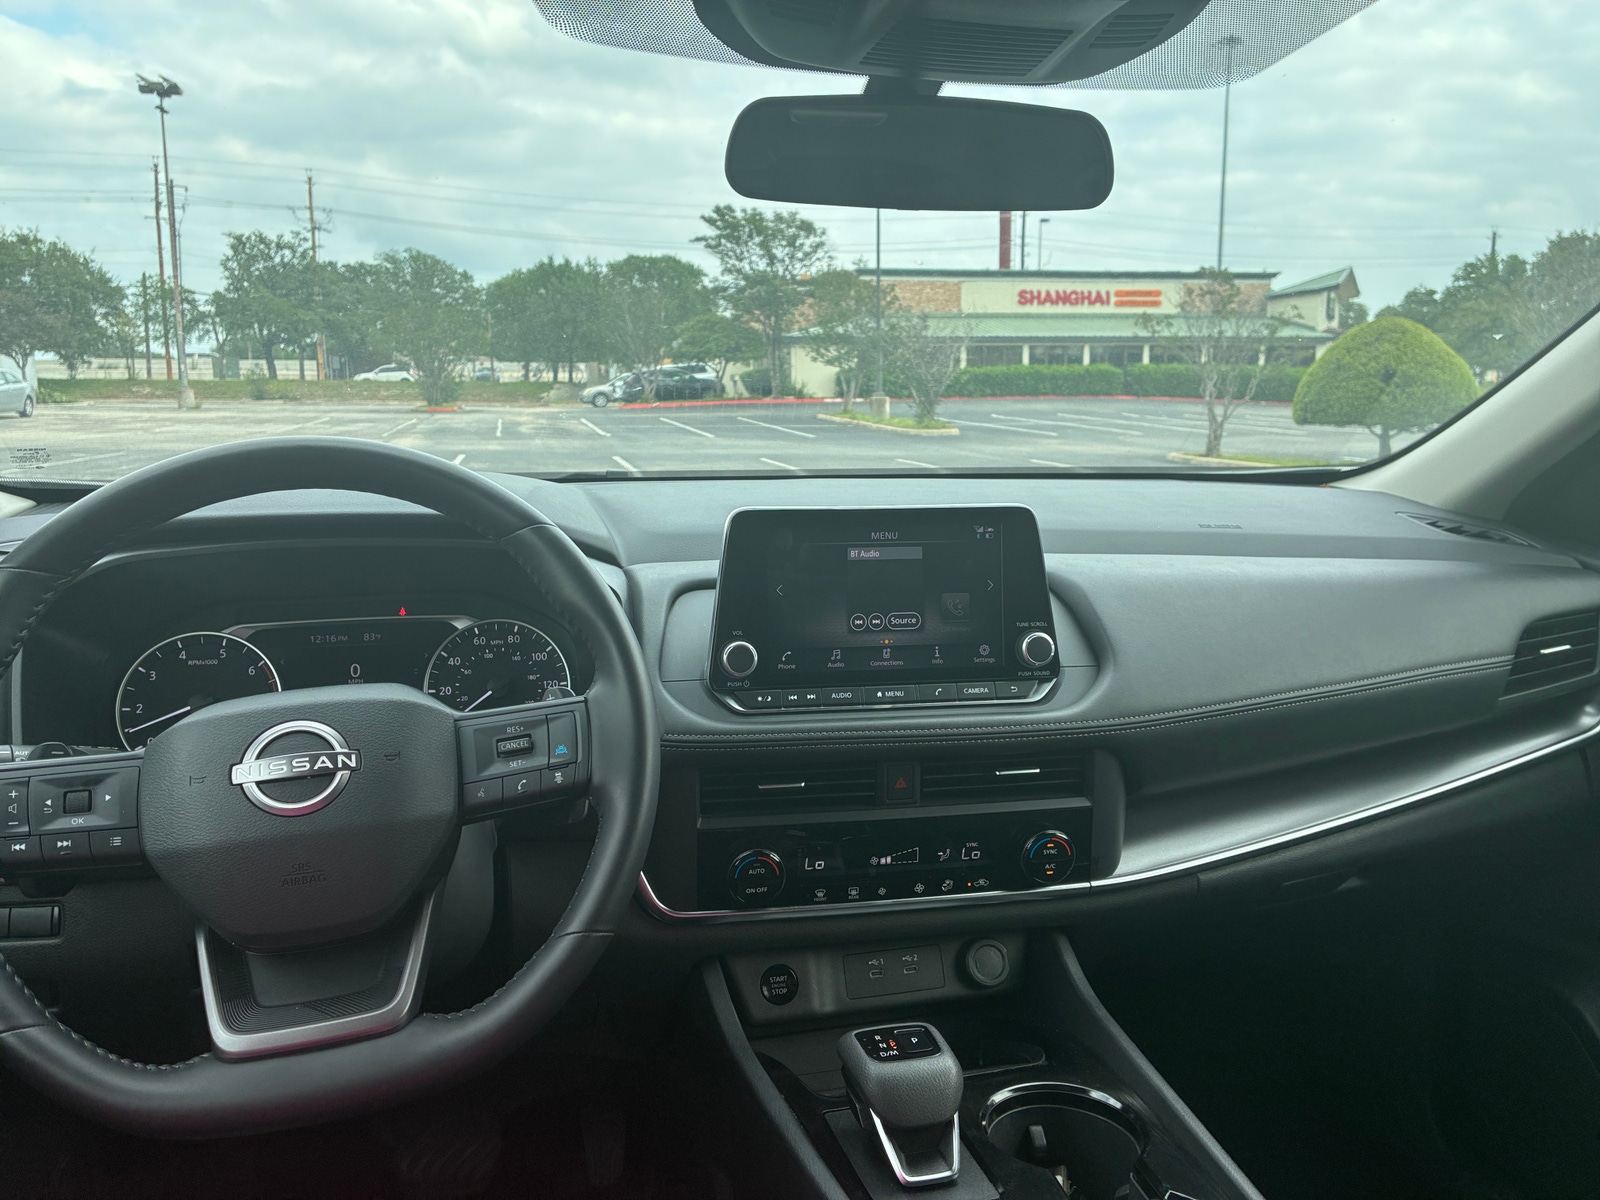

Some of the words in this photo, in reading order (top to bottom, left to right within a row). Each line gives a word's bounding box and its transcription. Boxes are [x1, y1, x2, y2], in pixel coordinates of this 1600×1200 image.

[1017, 289, 1111, 306] SHANGHAI
[871, 531, 898, 540] MENU
[850, 550, 859, 558] BT
[860, 549, 880, 558] Audio
[890, 616, 917, 625] Source
[310, 634, 337, 643] 12:16
[473, 636, 486, 646] 60
[507, 634, 521, 643] 80
[178, 650, 187, 660] 4
[219, 648, 227, 659] 5
[531, 652, 548, 661] 100
[447, 656, 461, 666] 40
[248, 666, 256, 676] 6
[350, 663, 361, 678] 0
[149, 671, 157, 681] 3
[543, 680, 559, 689] 120
[439, 686, 452, 696] 20
[885, 690, 905, 698] MENU
[136, 703, 143, 714] 2
[506, 725, 525, 734] RES+
[500, 740, 529, 751] CANCEL
[235, 753, 357, 781] NISSAN
[291, 862, 312, 873] SRS
[748, 867, 765, 875] AUTO
[281, 873, 327, 888] AIRBAG
[769, 975, 788, 983] START
[771, 987, 788, 996] STOP
[880, 1050, 899, 1058] D/M
